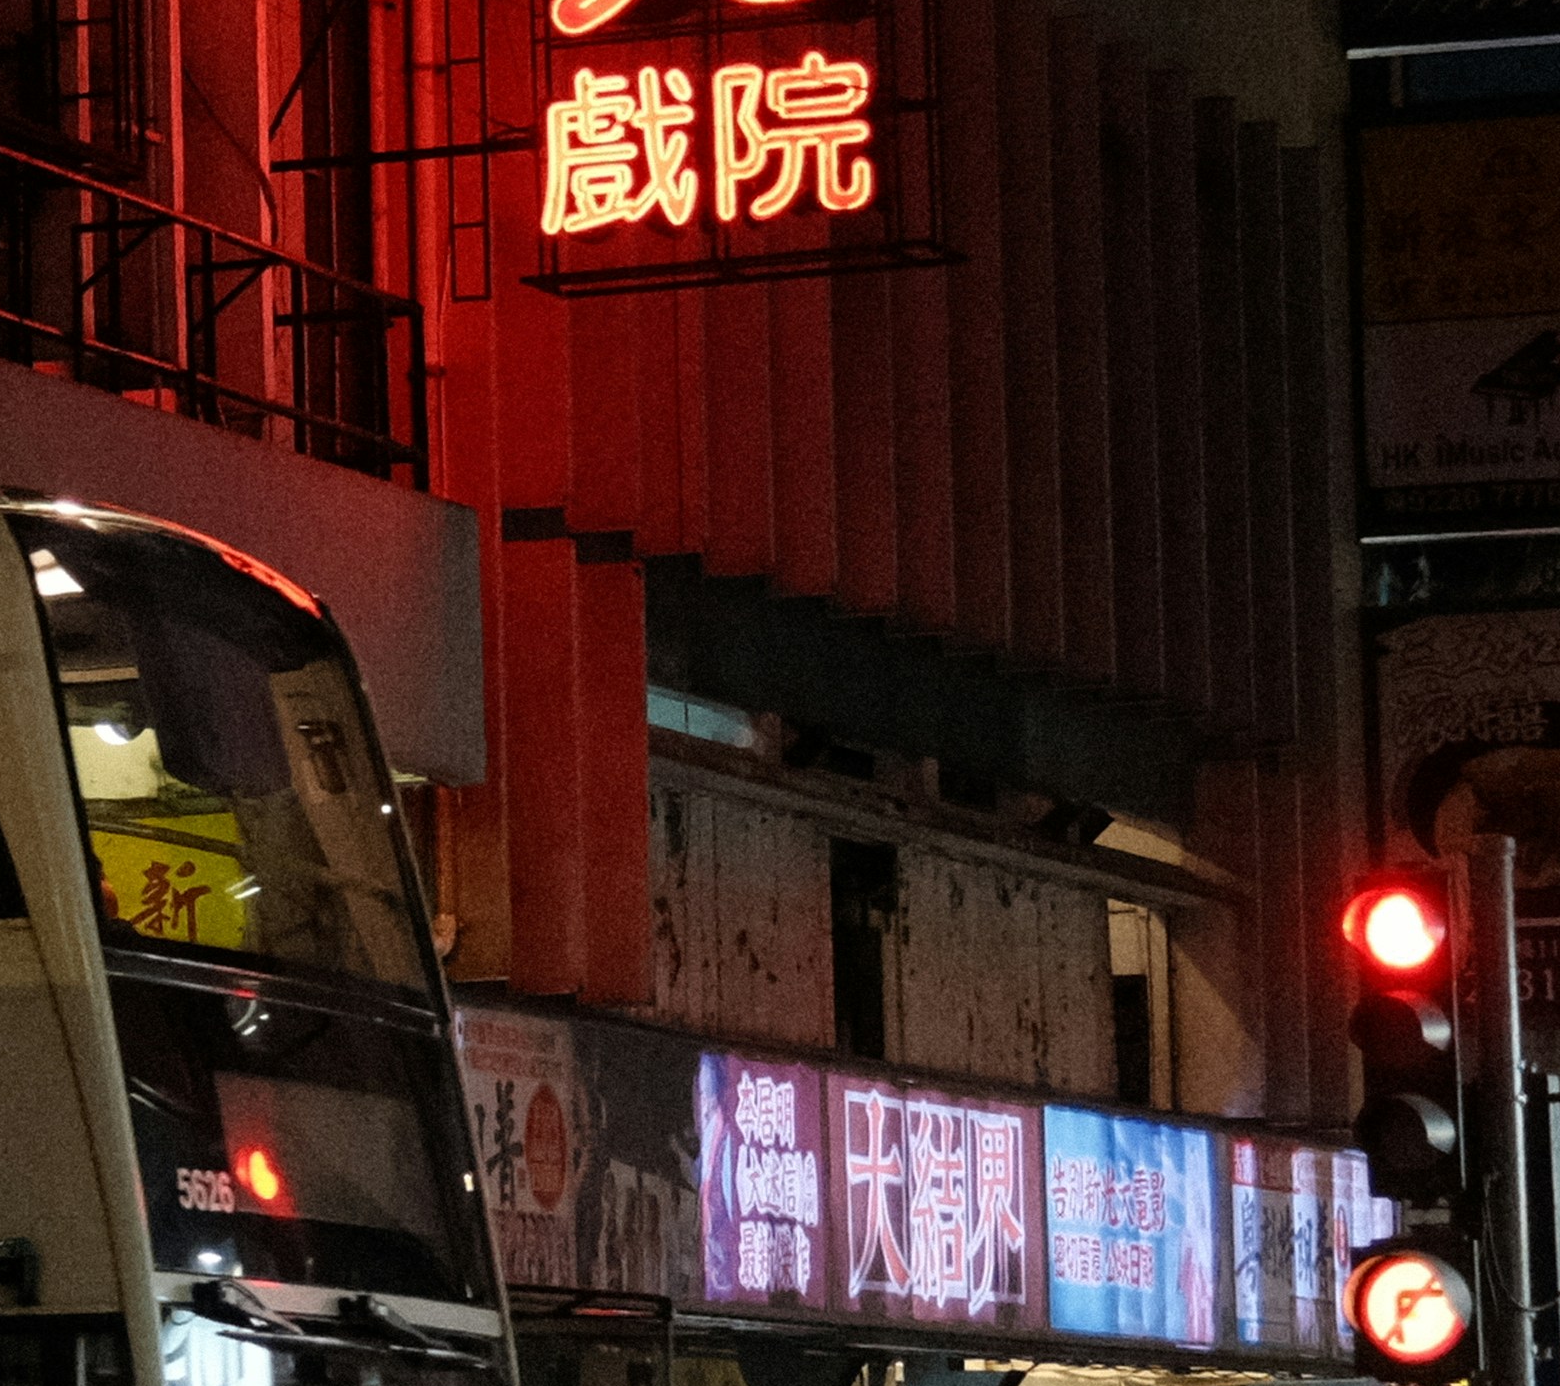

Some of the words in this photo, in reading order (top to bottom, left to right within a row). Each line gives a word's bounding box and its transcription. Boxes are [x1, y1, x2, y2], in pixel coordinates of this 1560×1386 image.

[540, 50, 873, 236] 戲院
[1381, 442, 1421, 470] HK
[132, 860, 211, 945] 新
[177, 1167, 237, 1215] 5626
[847, 1089, 1026, 1314] 大結界
